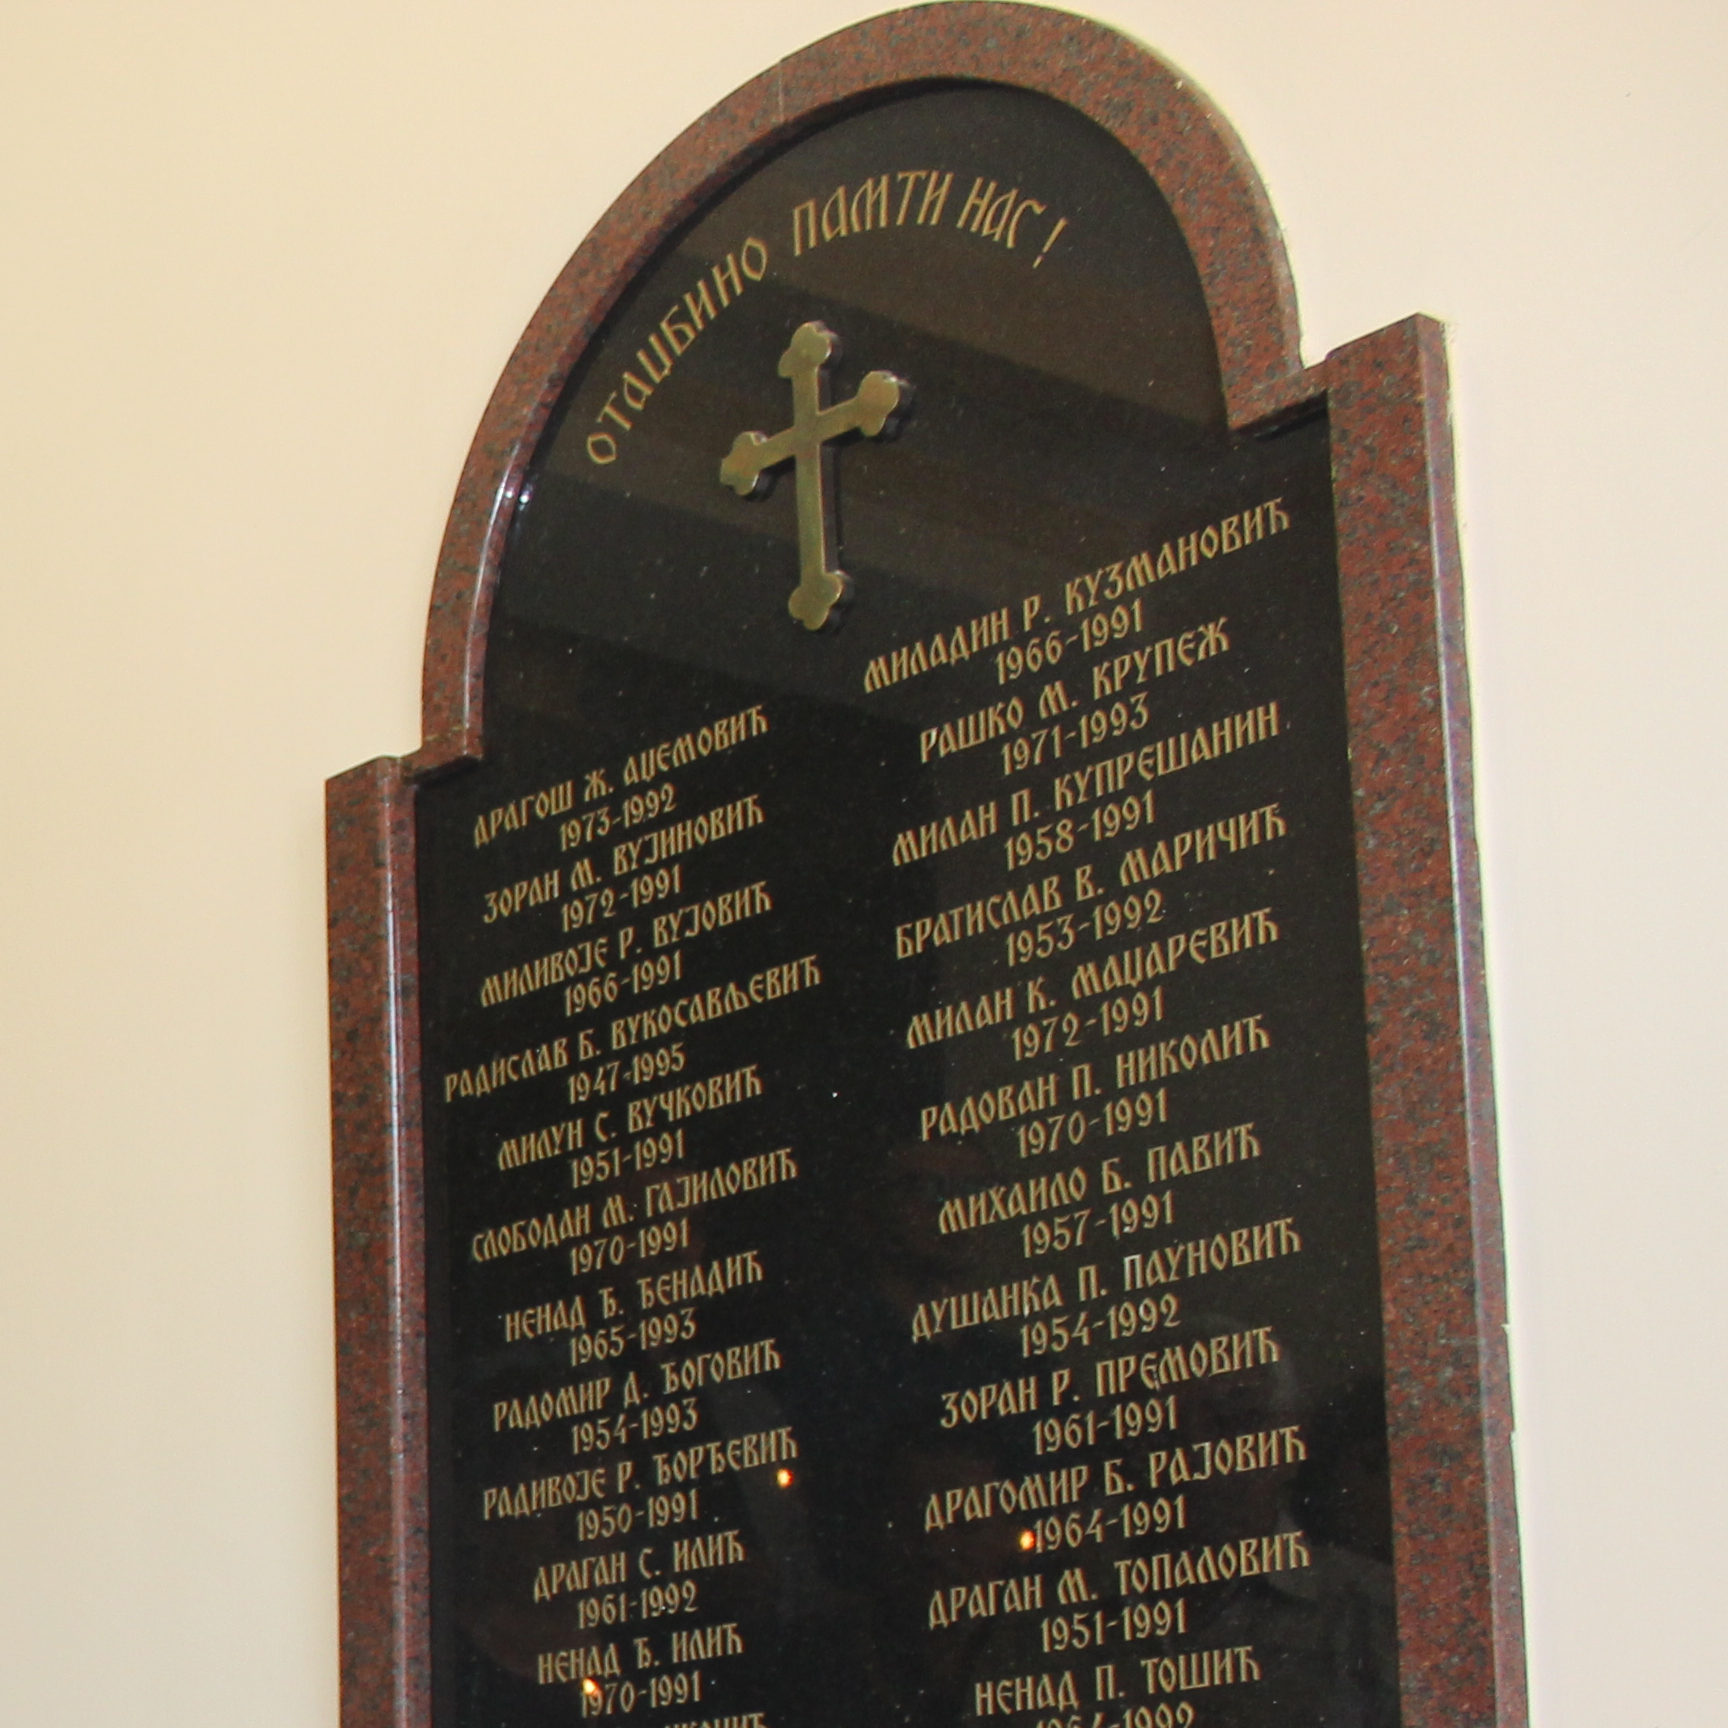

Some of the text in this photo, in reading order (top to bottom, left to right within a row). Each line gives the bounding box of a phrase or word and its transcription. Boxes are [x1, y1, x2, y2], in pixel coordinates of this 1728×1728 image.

[792, 170, 952, 256] ПАМТИ
[863, 497, 1291, 693] МИЛАДИН Р. КУЗМАНОВИЋ
[995, 599, 1144, 685] 1966-1991
[920, 617, 1230, 763] РАШКО М. КРУПЕЖ
[1001, 692, 1150, 775] 1971-1993
[474, 780, 574, 848] ДРАГОШ
[584, 769, 613, 803] Ж.
[559, 784, 677, 851] 1973-1992
[893, 701, 1280, 865] МИЛАН П. КУПРЕШАНИН
[483, 794, 766, 923] ЗОРАН М. ВУЈИНОВИЋ
[1004, 790, 1156, 870] 1958-1991
[562, 865, 681, 932] 1972-1991
[895, 802, 1289, 959] БРАТИСЛАВ В. МАРИЧИЋ
[480, 881, 773, 1007] МИЛИВОЈЕ Р. ВУЈОВИЋ
[1006, 889, 1165, 966] 1953-1992
[565, 950, 682, 1017] 1966-1991
[907, 984, 1015, 1048] МИЛАН
[1027, 976, 1056, 1014] К.
[1012, 987, 1165, 1061] 1972-1991
[445, 1037, 568, 1101] РАДИСЛАВ
[579, 1029, 601, 1061] Б.
[568, 1043, 687, 1104] 1947-1995
[921, 1014, 1270, 1141] РАДОВАН П. НИКОЛИЋ
[498, 1064, 764, 1171] МИЛУН С. ВУЧКОВИЋ
[1018, 1089, 1167, 1158] 1970-1991
[571, 1129, 685, 1188] 1951-1991
[938, 1122, 1261, 1234] МИХАИЛО Б. ПАВИЋ
[471, 1148, 798, 1263] СЛОБОДАН М. ГАЈИЛОВИЋ
[1021, 1191, 1175, 1257] 1957-1991
[570, 1219, 689, 1276] 1970-1991
[911, 1220, 1302, 1342] ДУШАНКА П. ПАУНОВИЋ
[504, 1297, 586, 1342] НЕНАД
[570, 1308, 698, 1366] 1965-1993
[1020, 1295, 1181, 1357] 1954-1992
[494, 1376, 611, 1431] РАДОМИР
[624, 1371, 648, 1406] Д.
[941, 1326, 1280, 1429] ЗОРАН Р. ПРЕМОВИЋ
[572, 1398, 699, 1454] 1954-1993
[1034, 1397, 1177, 1455] 1961-1991
[484, 1467, 606, 1520] РАДИВОЈЕ
[618, 1461, 640, 1494] Р.
[925, 1425, 1307, 1532] ДРАГОМИР Б. РАЈОВИЋ
[577, 1490, 700, 1541] 1950-1991
[1033, 1495, 1186, 1553] 1964-1991
[534, 1530, 746, 1603] ДРАГАН С. ИЛИЋ
[929, 1531, 1311, 1630] ДРАГАН М. ТОПАЛОВИЋ
[578, 1581, 699, 1629] 1961-1992
[1041, 1598, 1187, 1652] 1951-1991
[537, 1643, 621, 1685] НЕНАД
[672, 1623, 744, 1663] ИЛИЋ
[975, 1646, 1262, 1716] НЕНАД П. ТОШИЋ
